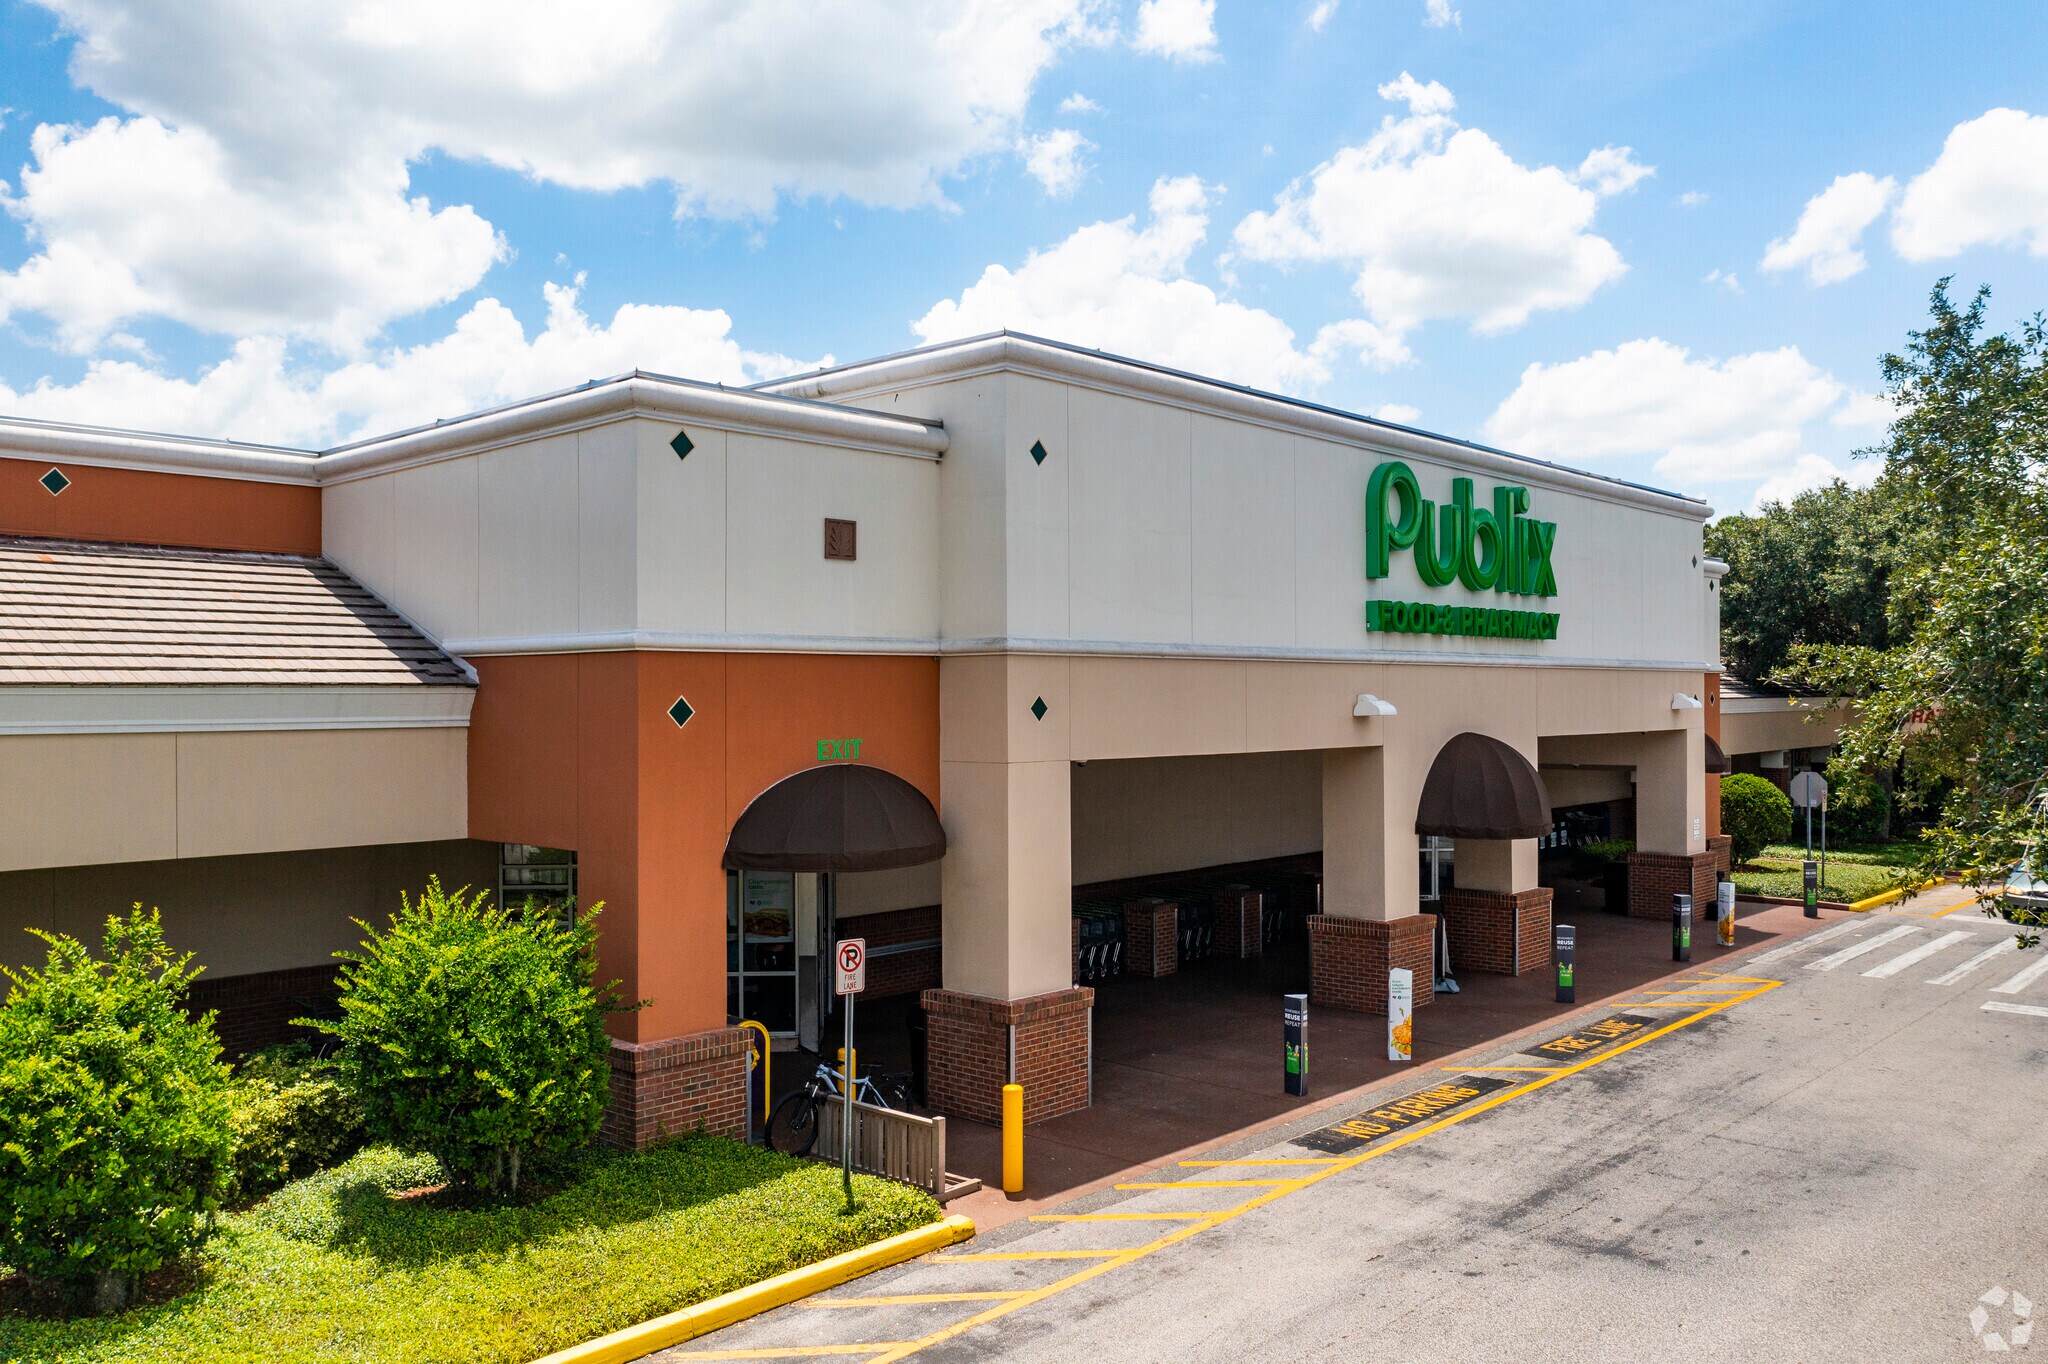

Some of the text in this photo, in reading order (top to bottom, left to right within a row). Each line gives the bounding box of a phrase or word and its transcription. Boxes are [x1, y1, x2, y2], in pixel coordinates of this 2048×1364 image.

[1366, 461, 1558, 597] Publix
[1366, 600, 1440, 634] FOOD
[1455, 607, 1560, 639] PHARMACY
[817, 738, 863, 761] EXIT
[844, 973, 856, 981] FIRE
[844, 982, 857, 990] LANE
[1285, 1012, 1300, 1021] REUSE
[1285, 1019, 1301, 1027] REPEAT
[1540, 1035, 1602, 1053] FIRE
[1331, 1085, 1480, 1139] NO PARKING
